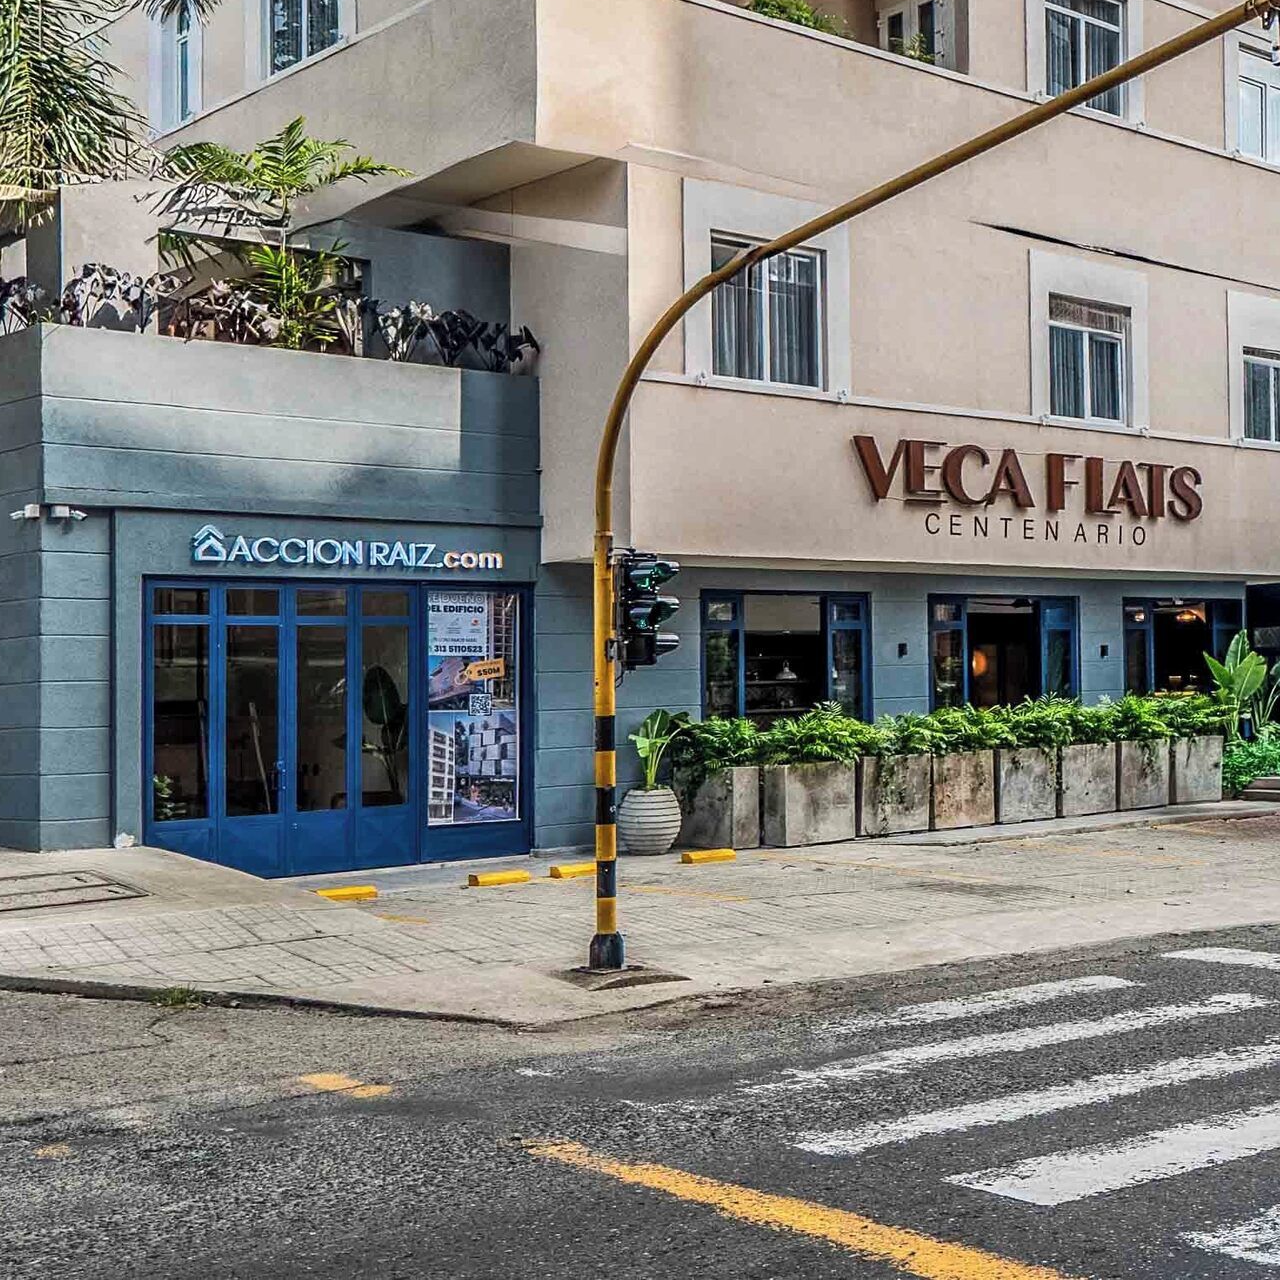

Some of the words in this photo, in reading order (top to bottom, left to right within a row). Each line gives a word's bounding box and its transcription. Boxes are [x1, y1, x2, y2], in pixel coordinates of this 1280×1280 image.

[851, 435, 1035, 509] VECA
[1045, 453, 1204, 522] FLATS
[924, 513, 1148, 546] CENTENARIO
[227, 535, 365, 565] ACCION
[444, 605, 484, 613] EDIFICIO
